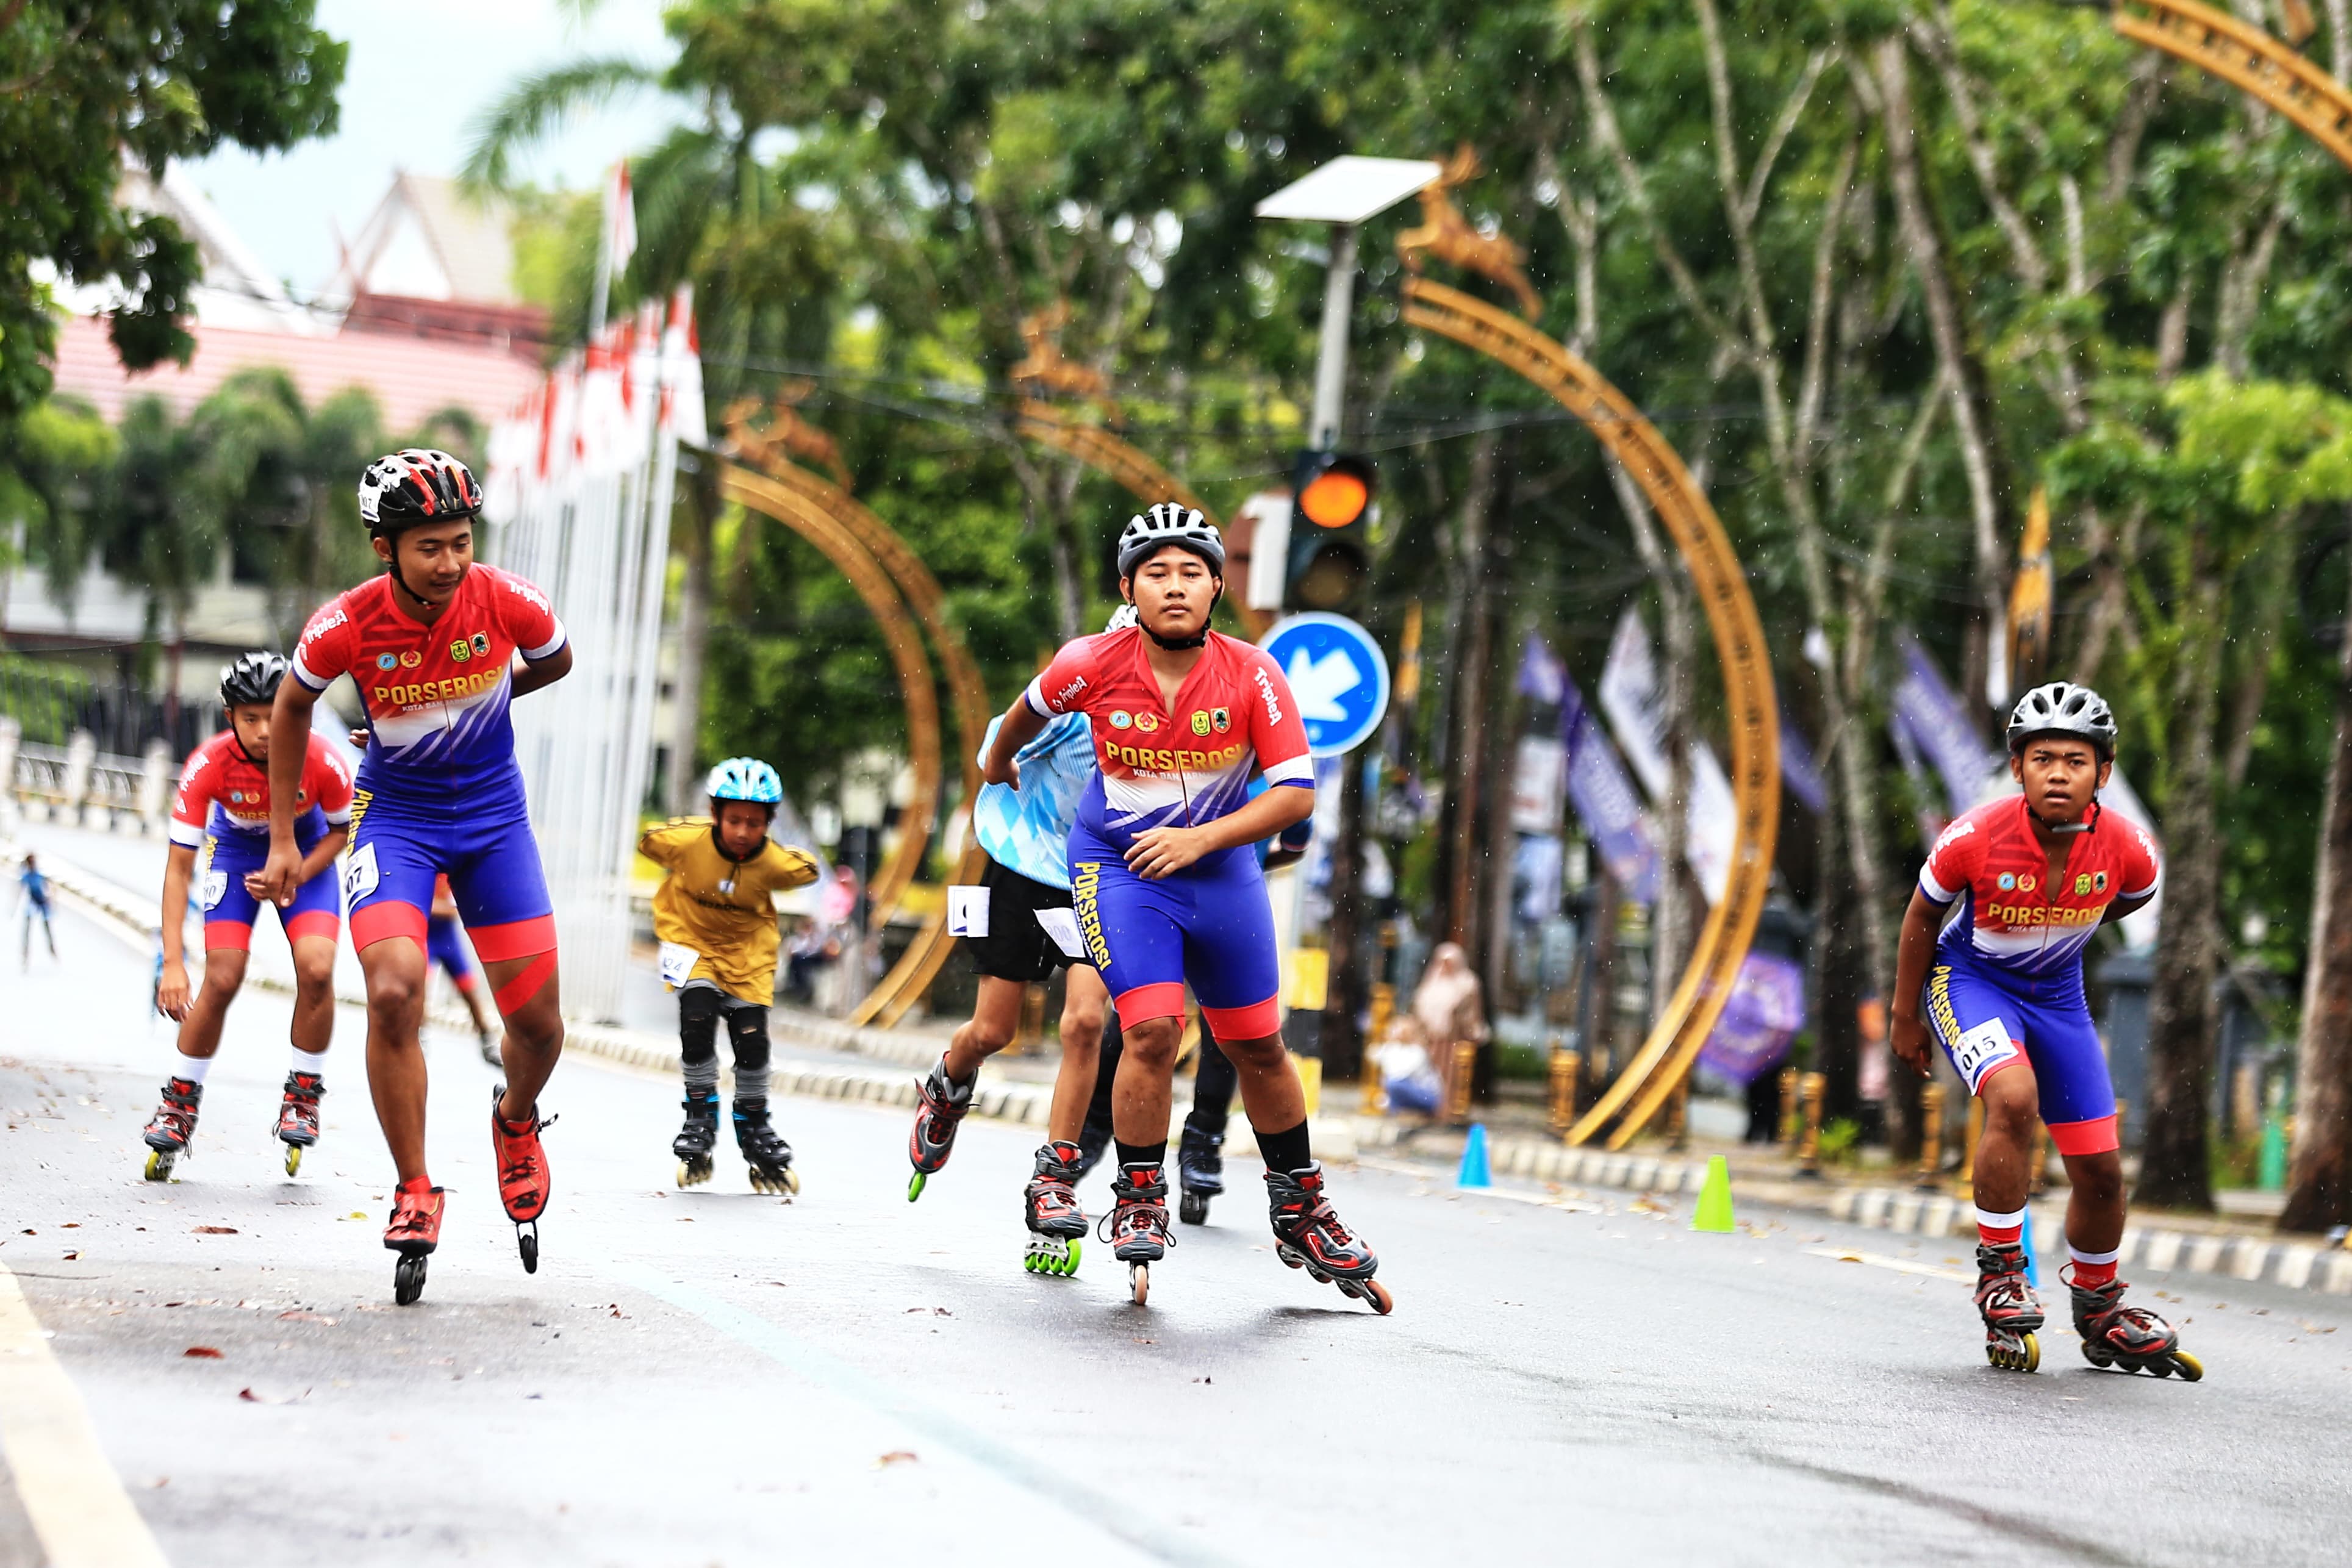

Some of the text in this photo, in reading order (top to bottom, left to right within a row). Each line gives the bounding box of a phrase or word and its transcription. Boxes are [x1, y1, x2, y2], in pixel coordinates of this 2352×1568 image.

[507, 579, 549, 617] TripleA
[306, 610, 348, 644] TripleA
[374, 665, 503, 705] PORSEROSI
[1058, 675, 1088, 703] TripleA
[1254, 666, 1283, 727] TripleA
[402, 703, 424, 712] KOTA
[1105, 740, 1243, 771] PORSEROSI
[1133, 768, 1158, 779] KOTA
[1074, 862, 1113, 971] PORSEROSI
[1988, 903, 2104, 925] PORSEROS
[1962, 1036, 1996, 1071] 015
